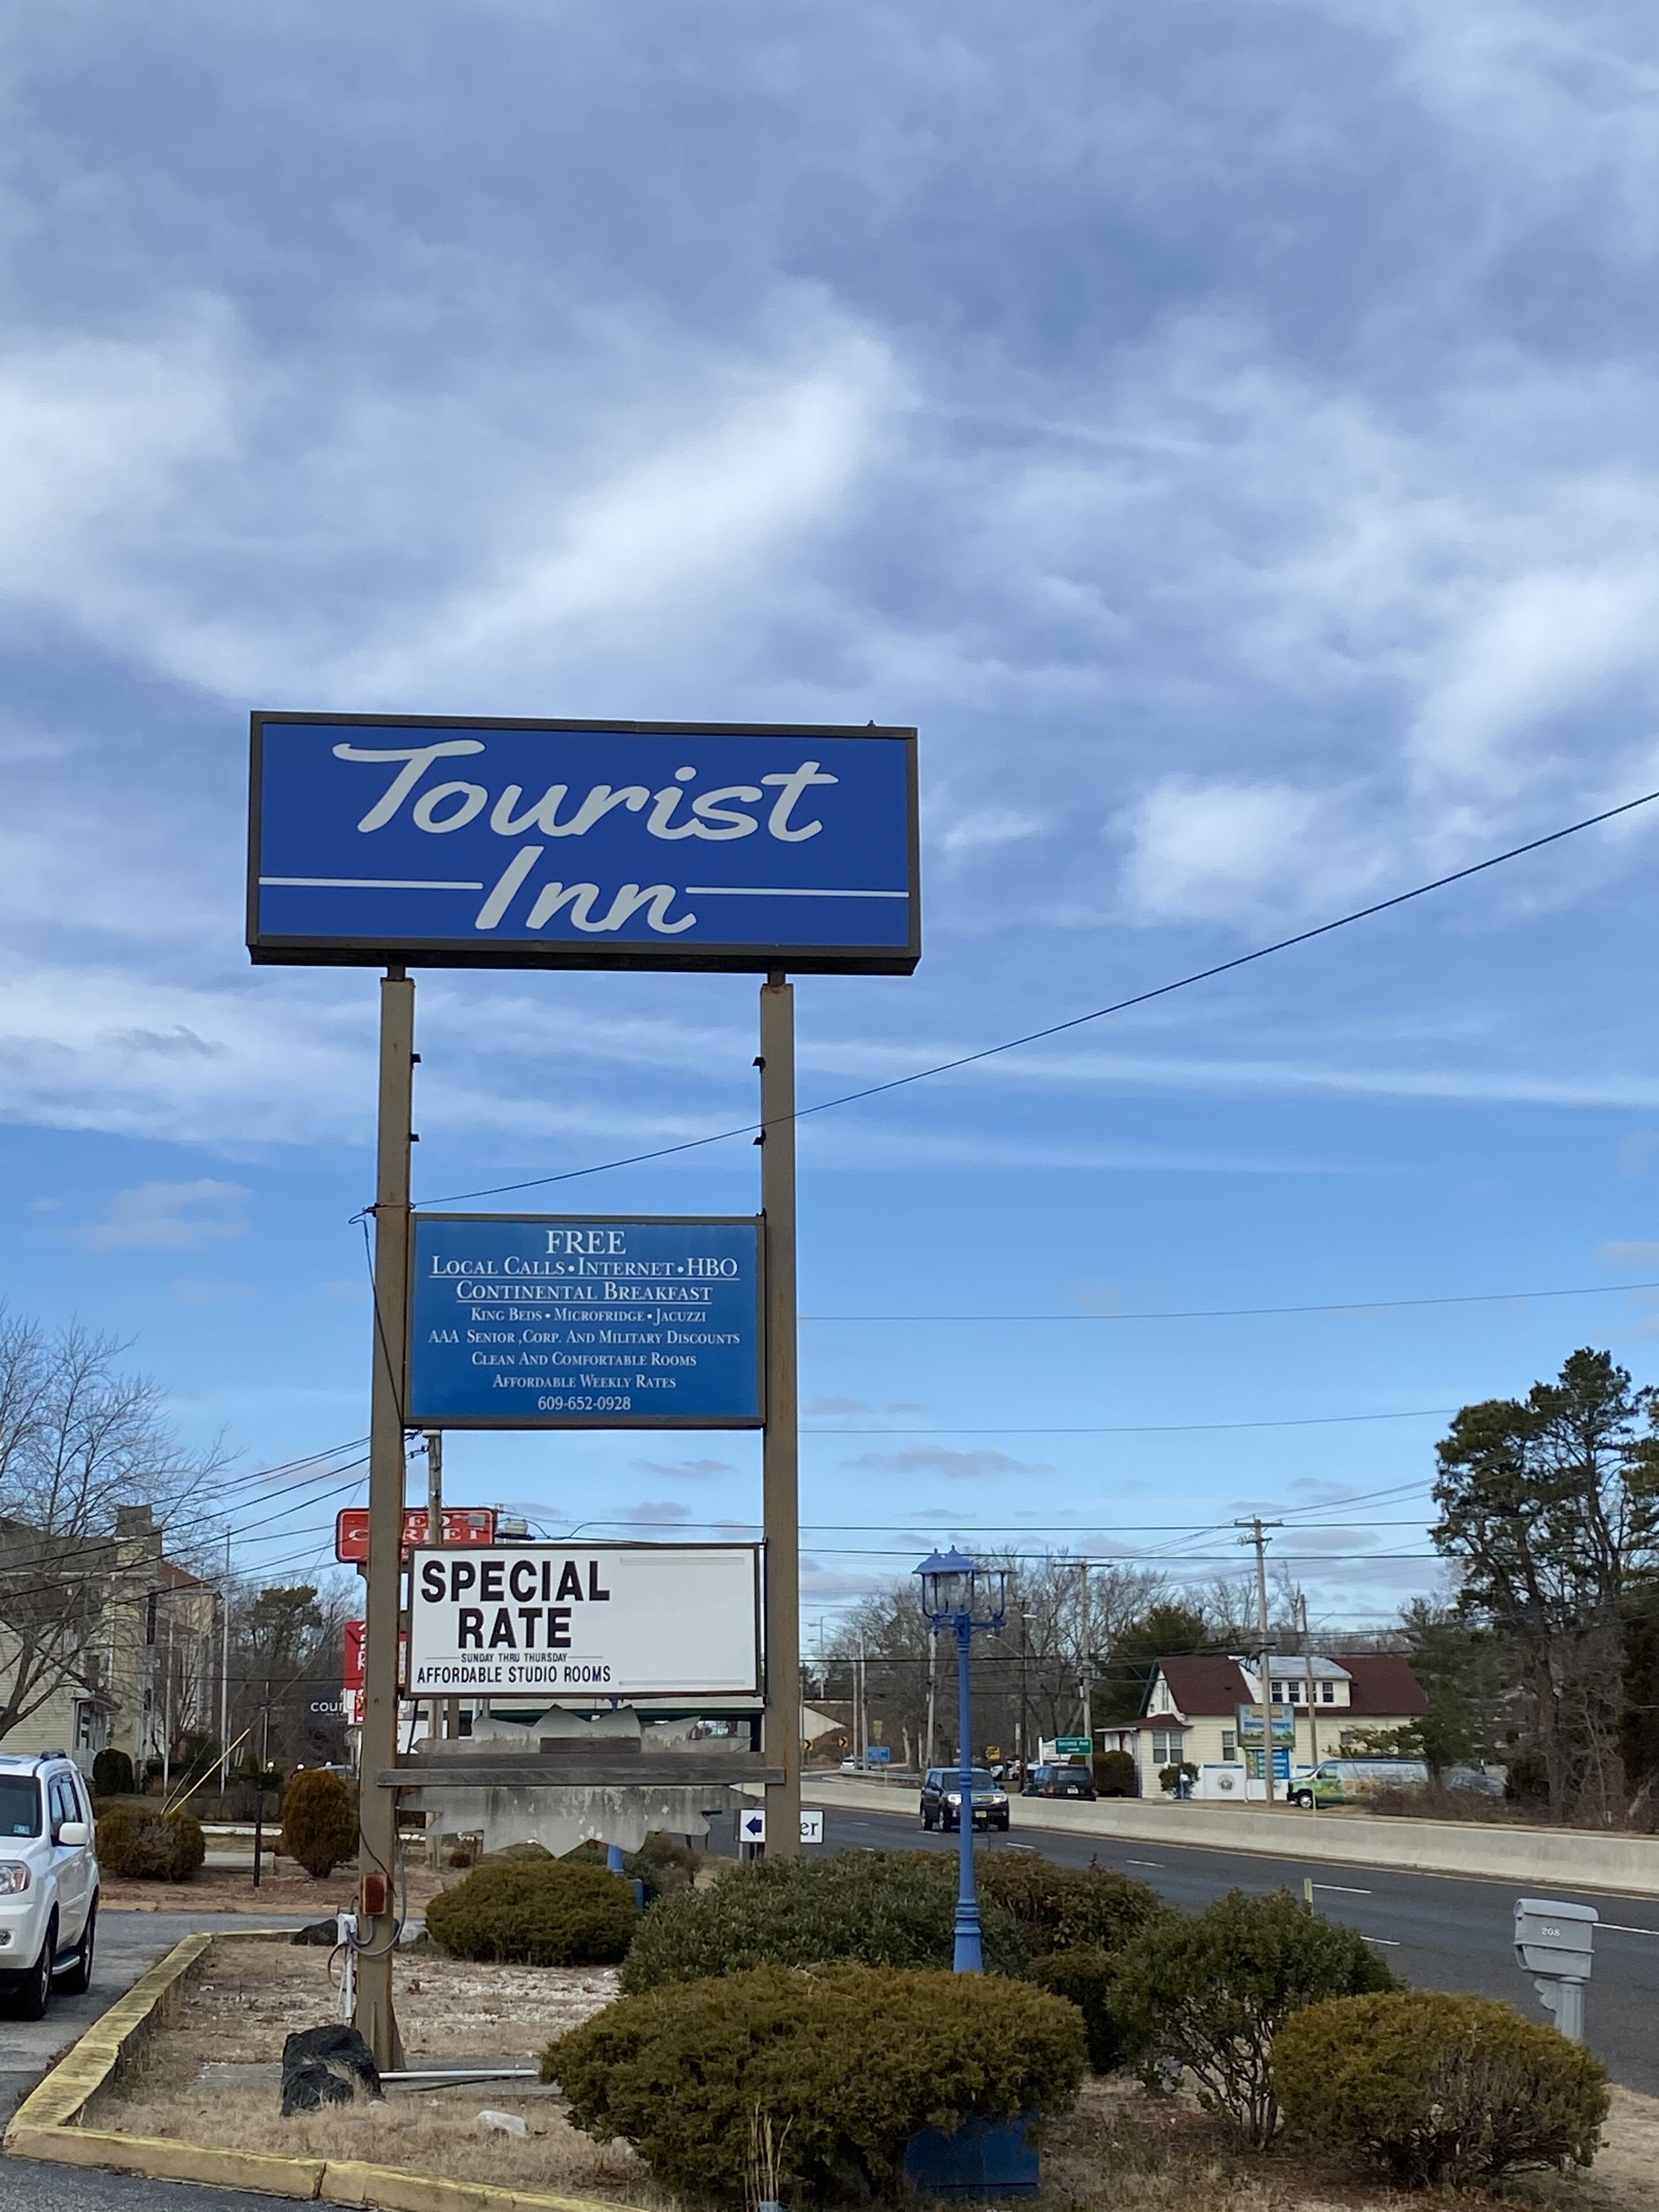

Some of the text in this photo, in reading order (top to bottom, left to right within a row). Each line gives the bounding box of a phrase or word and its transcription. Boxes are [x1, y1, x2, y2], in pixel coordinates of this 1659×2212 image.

[332, 740, 839, 842] Tourist
[475, 846, 696, 934] Inn
[546, 1230, 627, 1254] FREE
[432, 1255, 738, 1277] LOCAL CALLS INTERNET HBO
[457, 1280, 713, 1301] CONTINENTAL BREAKFAST
[471, 1307, 706, 1326] KING BEDS MICROFRIDGE JACUZZI
[428, 1330, 460, 1343] AAA
[566, 1330, 594, 1343] AND
[599, 1330, 662, 1343] MILITARY
[666, 1330, 740, 1344] DISCOUNTS
[472, 1351, 696, 1366] CLEAN AND COMFORTABLE ROOMS
[493, 1374, 676, 1388] AFFORDABLE WEEKLY RATES
[537, 1396, 631, 1410] 609-652-0928
[422, 1560, 610, 1603] SPECIAL
[458, 1607, 571, 1648] RATE
[461, 1652, 567, 1662] SUNDAY THRU THURSDAY
[417, 1665, 611, 1683] AFFORDABLE STUDIO ROOMS
[1541, 1926, 1560, 1937] 208
